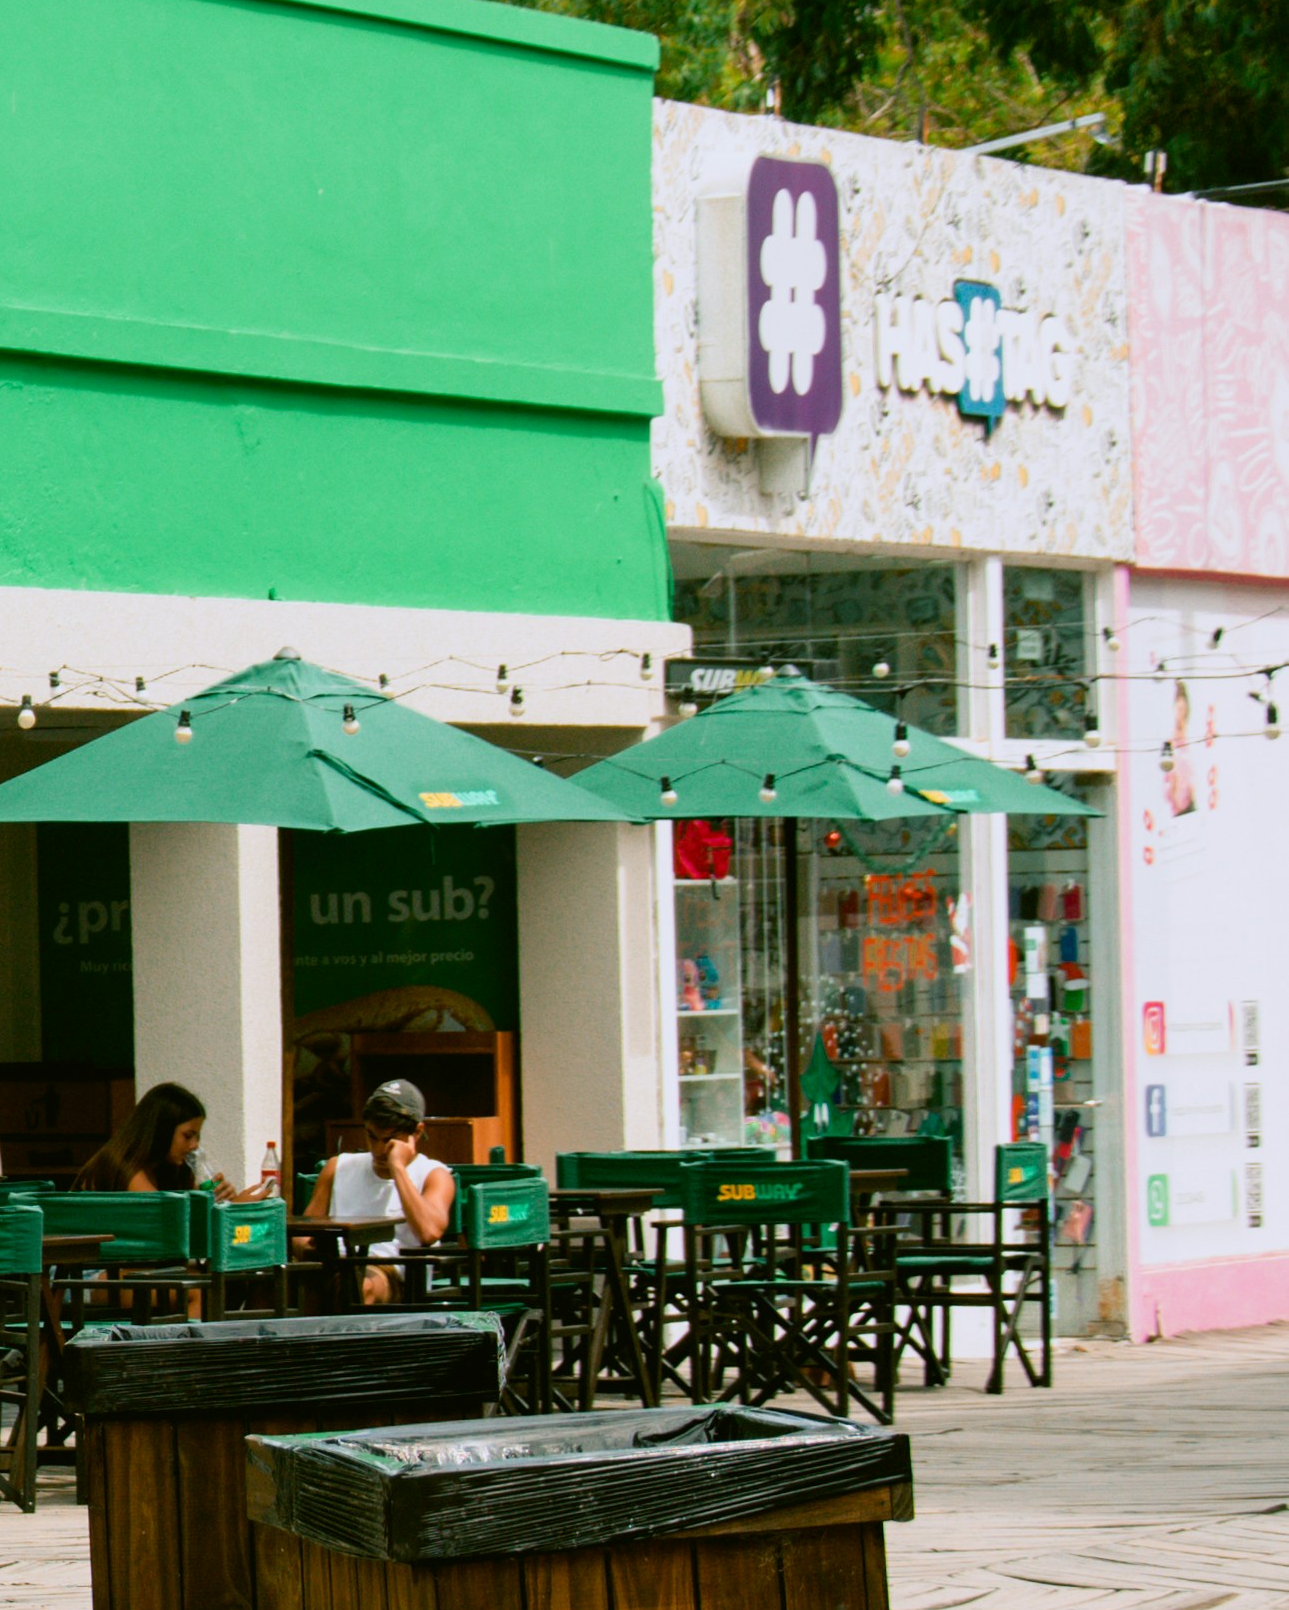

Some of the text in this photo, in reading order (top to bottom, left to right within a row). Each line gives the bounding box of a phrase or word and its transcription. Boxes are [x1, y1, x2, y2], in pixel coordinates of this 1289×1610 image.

[690, 667, 776, 695] SUBW
[310, 875, 495, 925] un sub?
[80, 960, 109, 975] Muy
[292, 955, 318, 967] nte
[332, 955, 357, 966] vos
[359, 954, 368, 968] y
[371, 951, 383, 964] al
[386, 950, 428, 966] mejor
[430, 948, 475, 965] precio
[717, 1182, 804, 1202] SUBWAY
